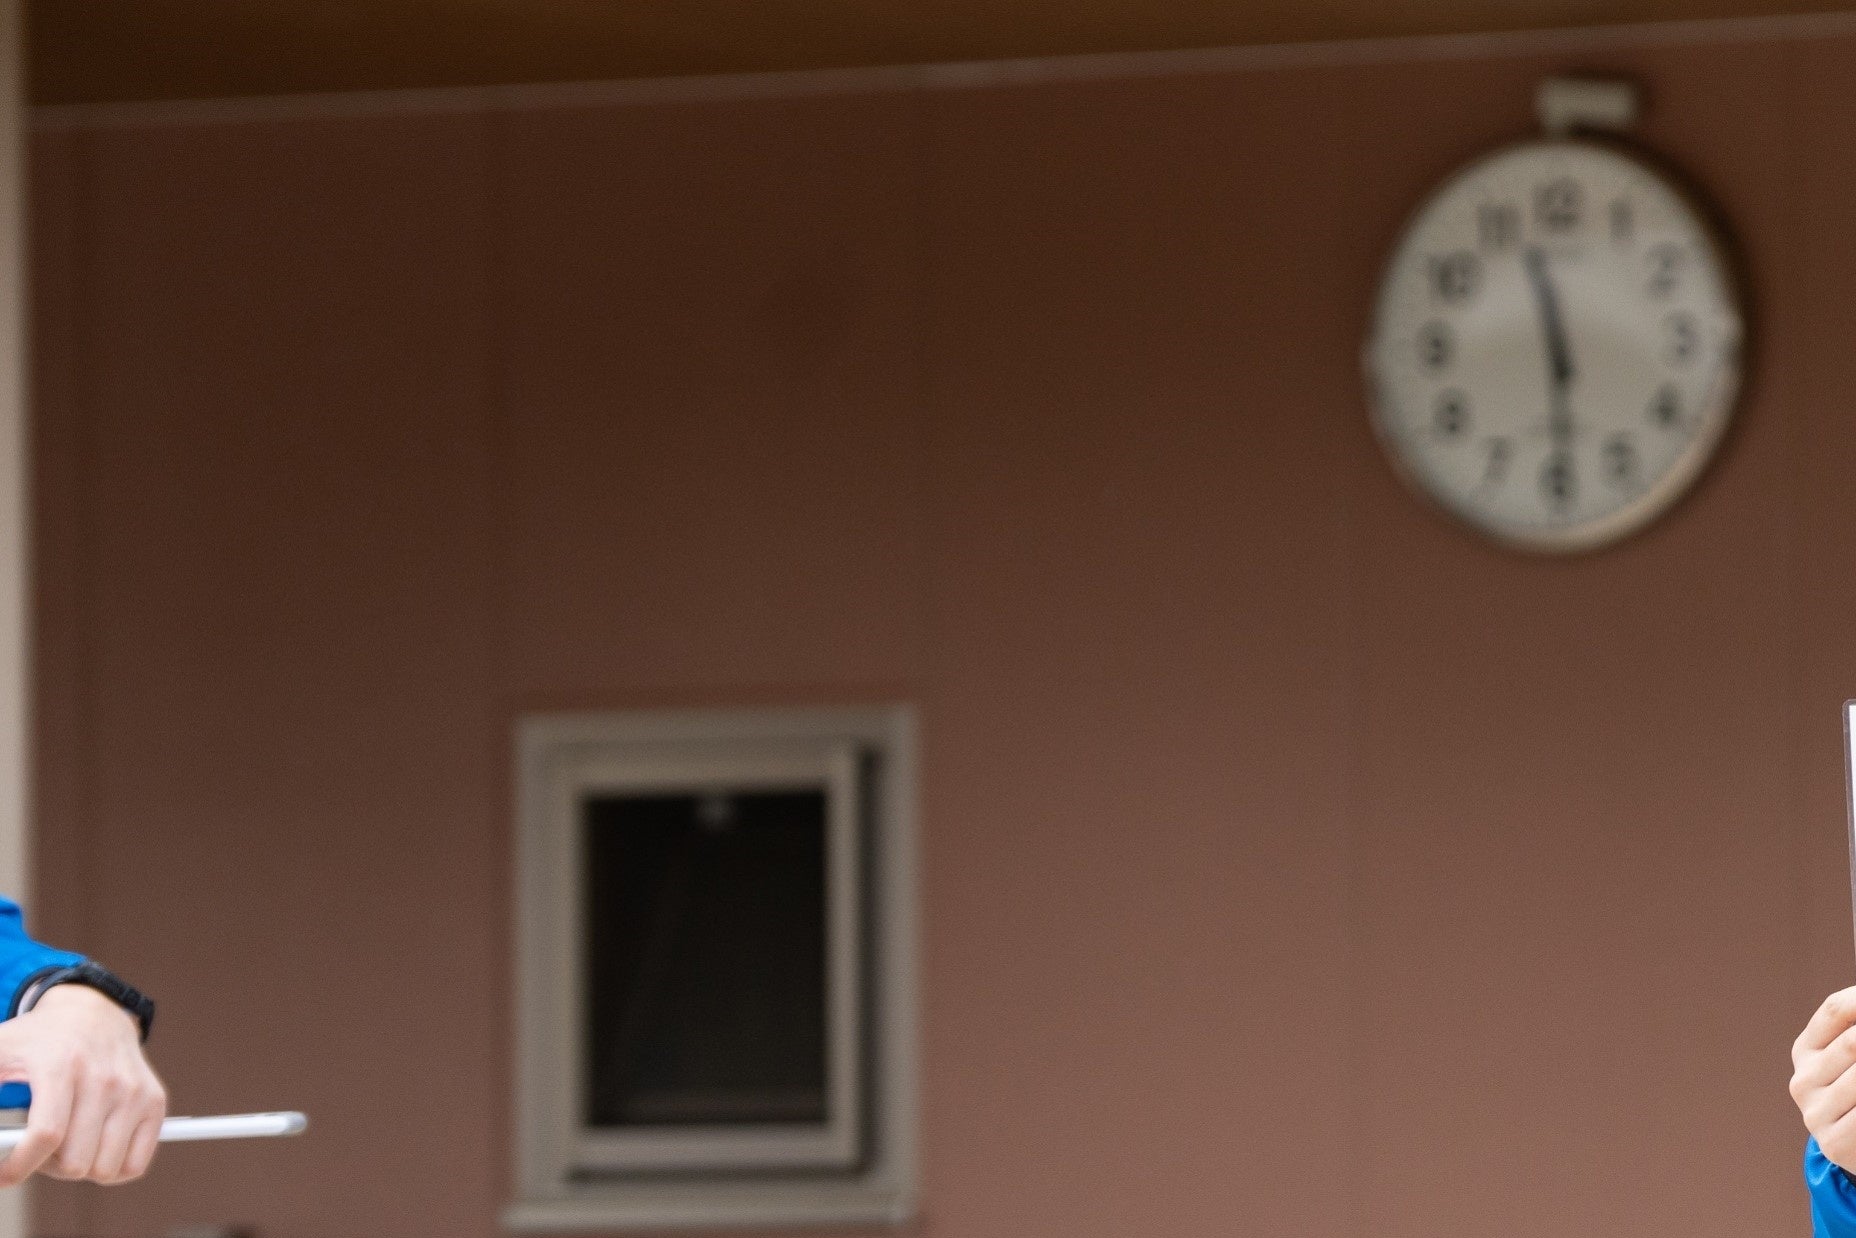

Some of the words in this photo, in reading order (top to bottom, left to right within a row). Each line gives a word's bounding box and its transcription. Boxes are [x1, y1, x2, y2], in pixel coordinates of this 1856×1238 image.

[1531, 177, 1586, 234] 12
[1429, 249, 1483, 304] 10
[1648, 242, 1686, 297] 2
[1481, 434, 1516, 486] 7
